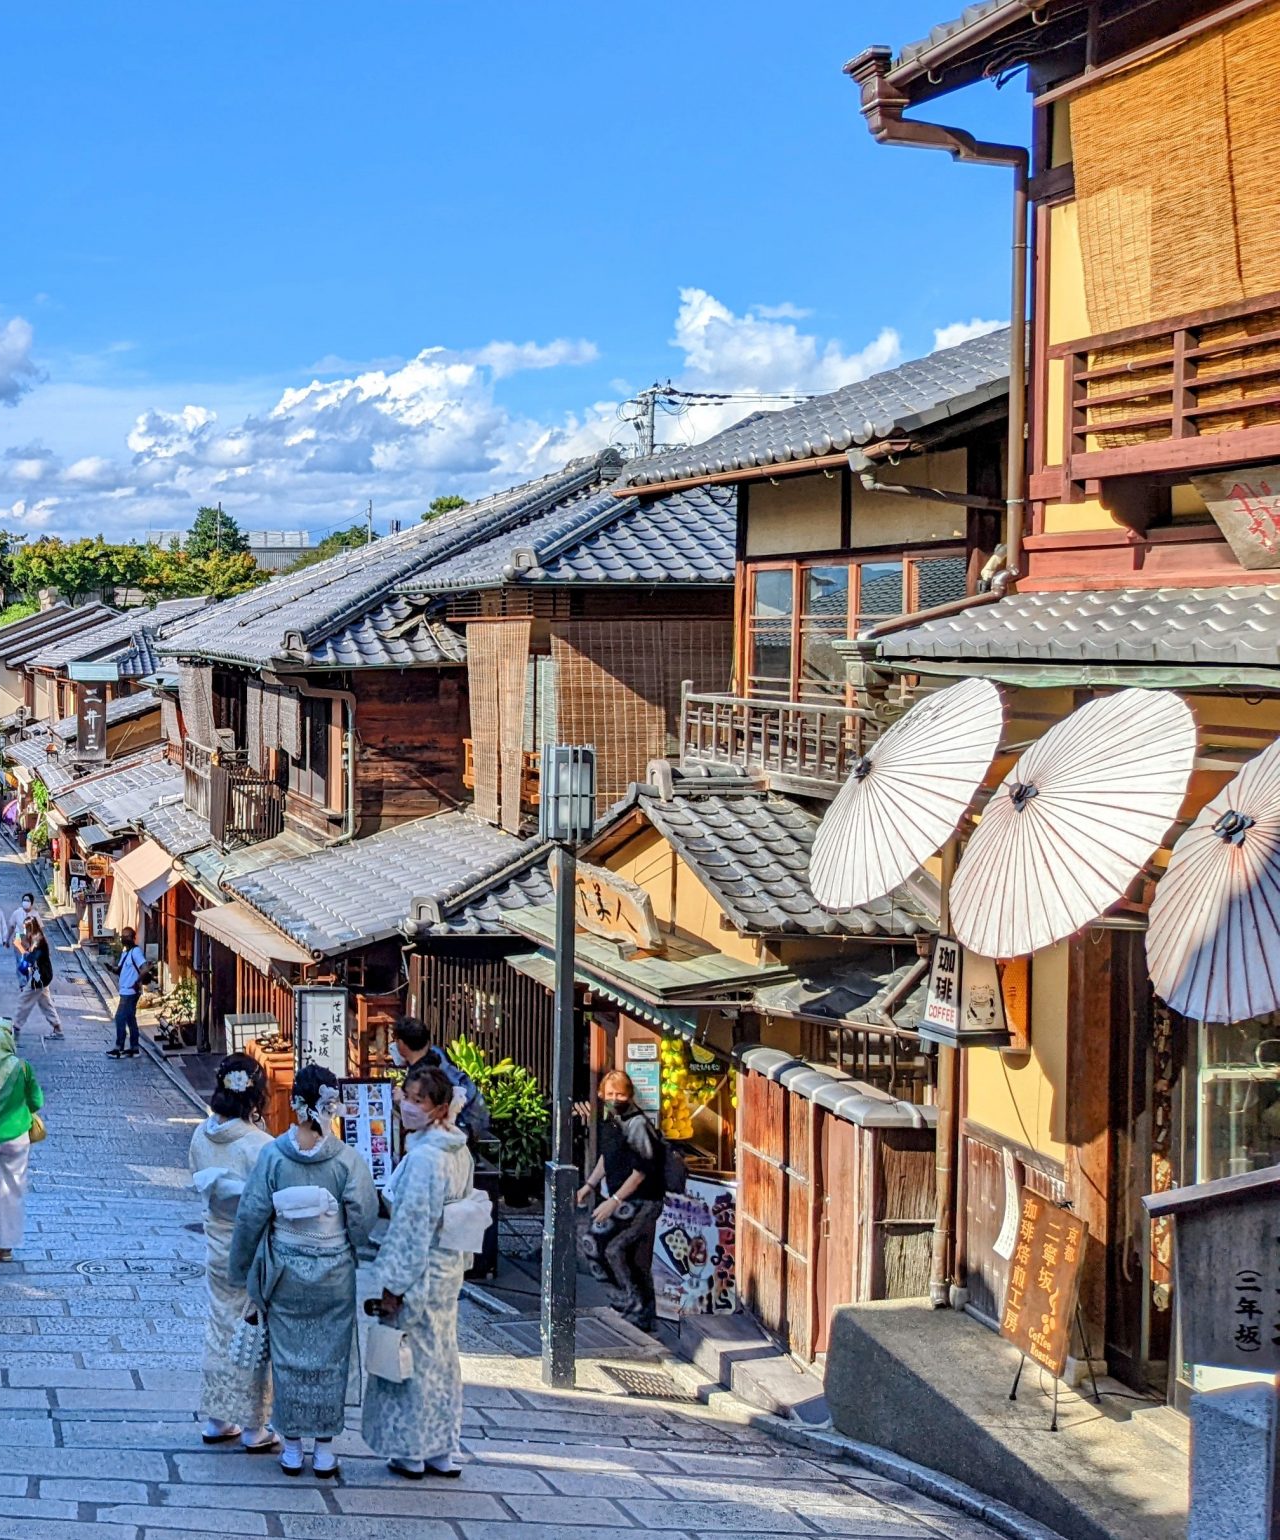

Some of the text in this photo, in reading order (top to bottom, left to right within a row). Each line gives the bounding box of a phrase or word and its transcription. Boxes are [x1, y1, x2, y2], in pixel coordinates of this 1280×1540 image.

[934, 946, 956, 1003] 珈琲
[332, 1000, 343, 1036] そば処
[928, 1003, 955, 1023] COFFEE
[1063, 1226, 1080, 1264] 京都
[1028, 1326, 1052, 1351] Coffee
[1029, 1341, 1058, 1370] Roaster
